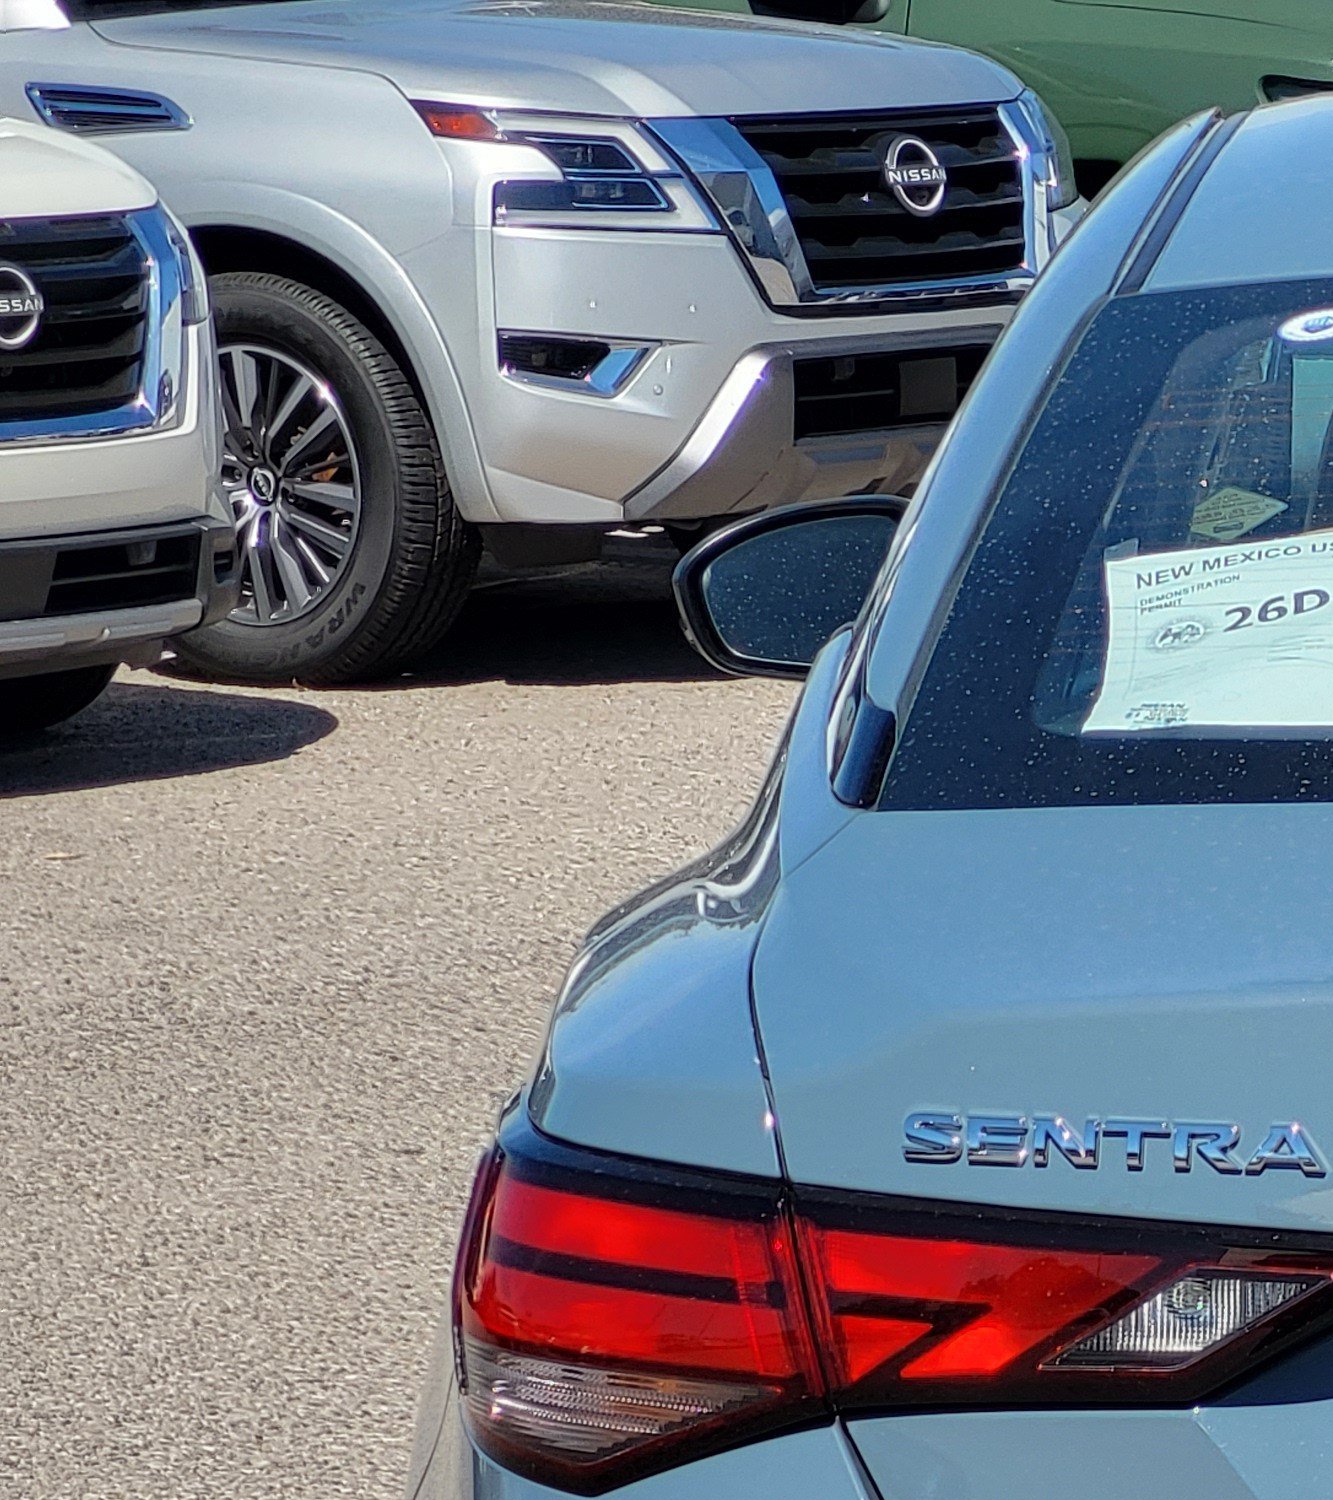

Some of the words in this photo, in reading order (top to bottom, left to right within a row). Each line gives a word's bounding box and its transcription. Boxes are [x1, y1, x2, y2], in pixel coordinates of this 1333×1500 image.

[888, 167, 947, 183] NISSAN
[0, 298, 44, 314] SSAN
[1135, 562, 1194, 590] NEW
[1202, 545, 1302, 573] MEXICO
[1139, 573, 1241, 606] DEMONSTRATION
[1140, 597, 1183, 615] PERMIT
[902, 1111, 1327, 1179] SENTRA
